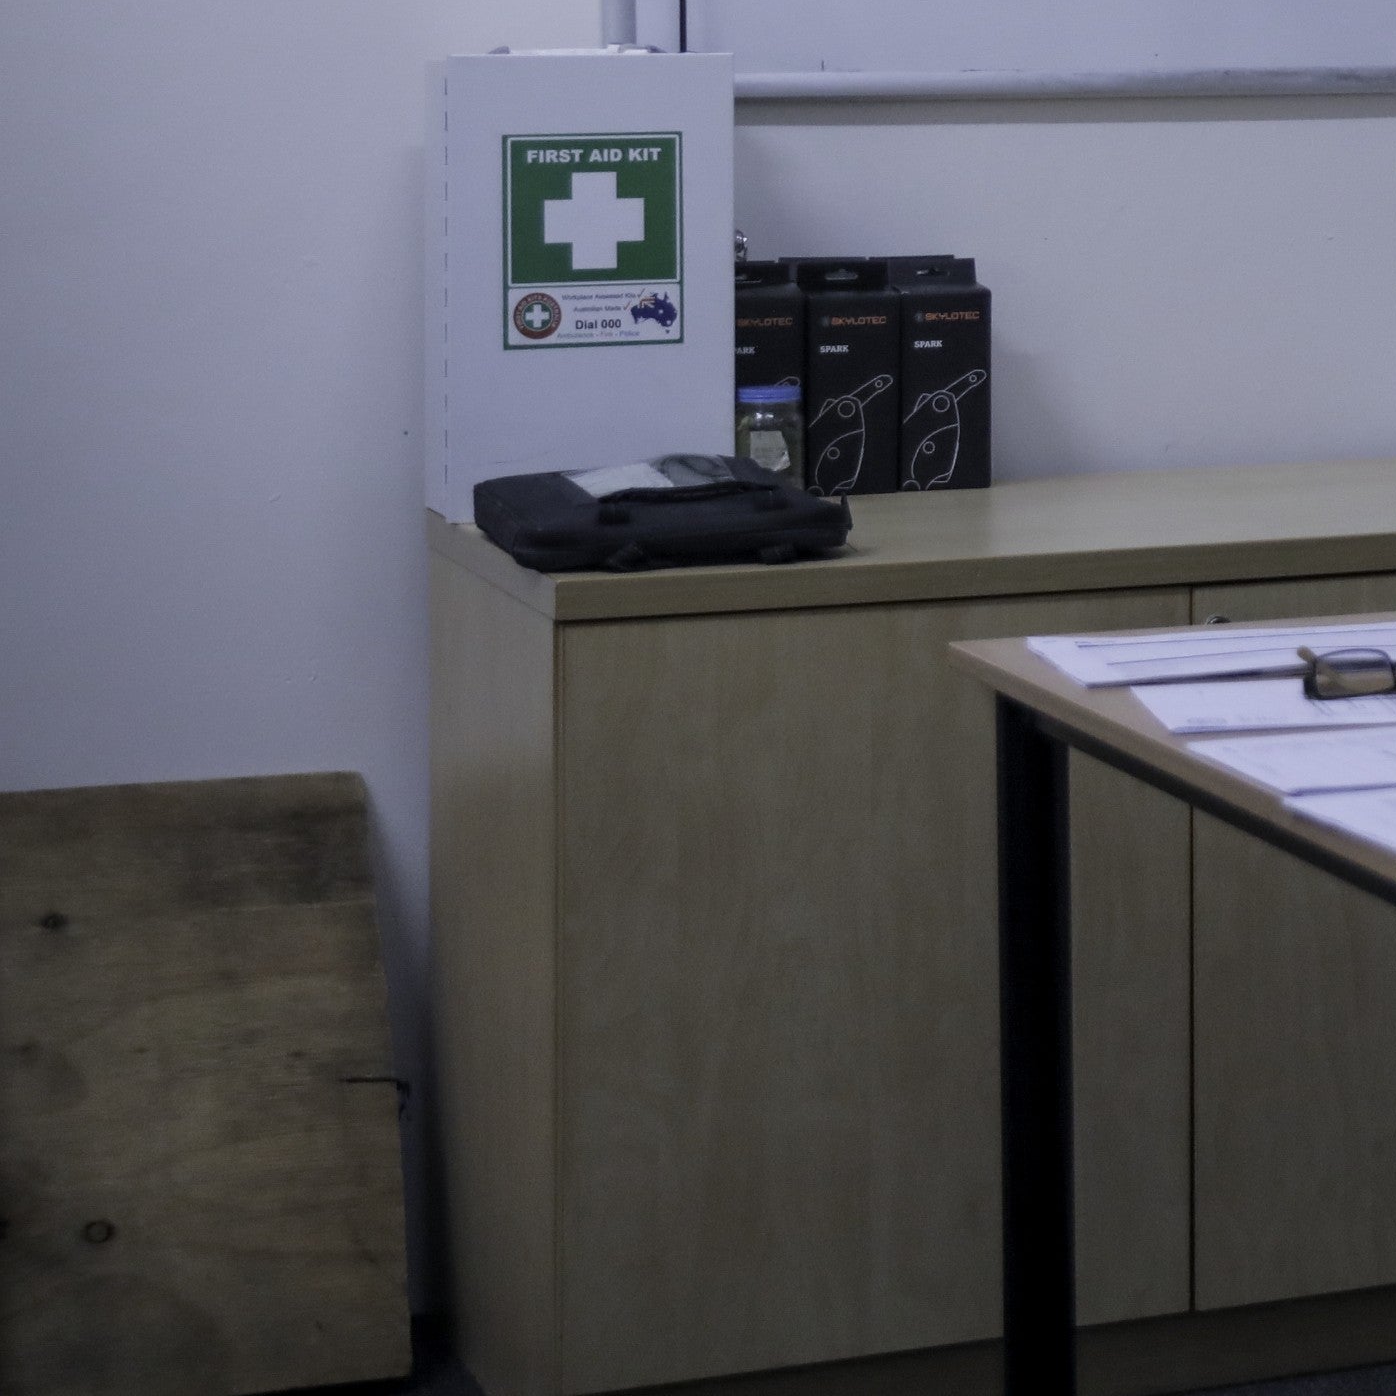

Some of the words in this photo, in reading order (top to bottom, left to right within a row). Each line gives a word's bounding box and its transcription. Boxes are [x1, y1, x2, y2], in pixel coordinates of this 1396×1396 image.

[526, 148, 584, 164] FIRST
[589, 147, 624, 162] AID
[628, 146, 663, 162] KIT
[575, 319, 598, 330] Dial
[601, 318, 622, 329] 000
[820, 344, 850, 354] SPARK
[914, 339, 943, 349] SPARK
